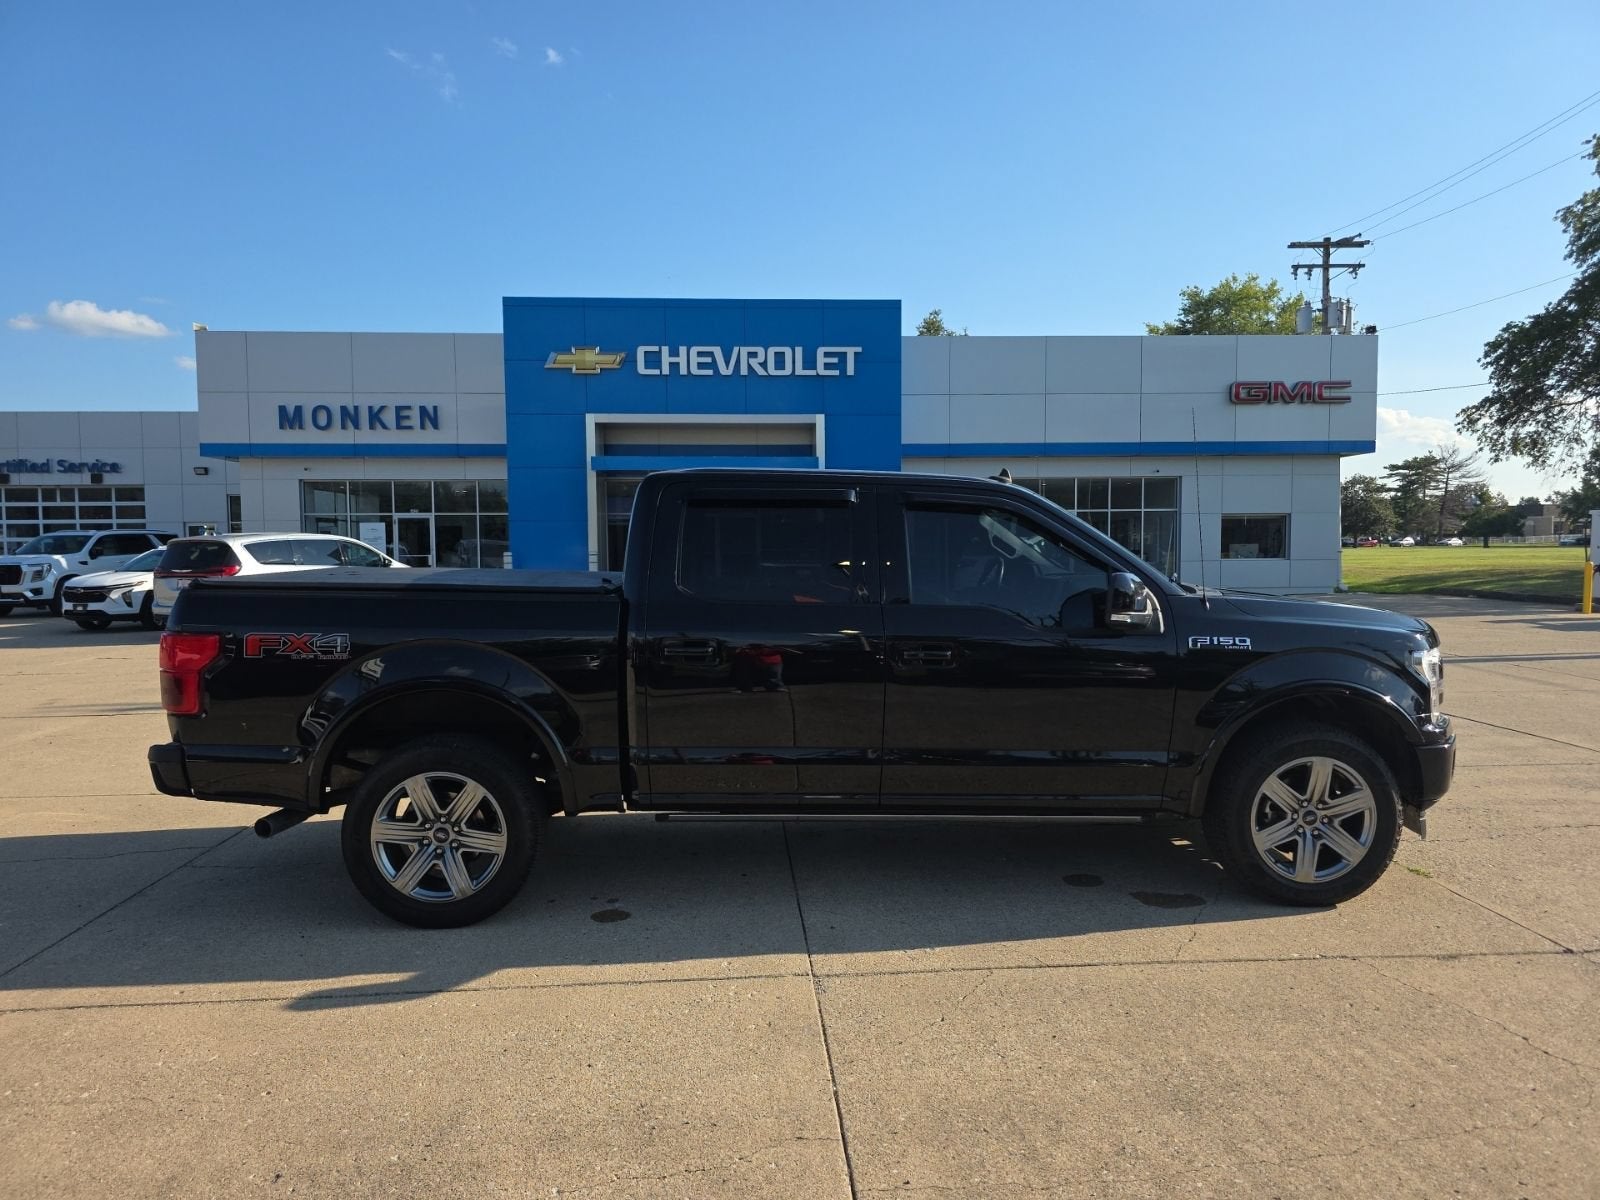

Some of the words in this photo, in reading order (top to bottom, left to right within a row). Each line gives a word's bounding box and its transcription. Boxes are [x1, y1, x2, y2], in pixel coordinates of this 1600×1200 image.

[636, 345, 863, 377] CHEVROLET
[1230, 380, 1352, 404] GMC
[278, 404, 441, 431] MONKEN
[56, 458, 122, 474] Service
[243, 632, 351, 658] FX4
